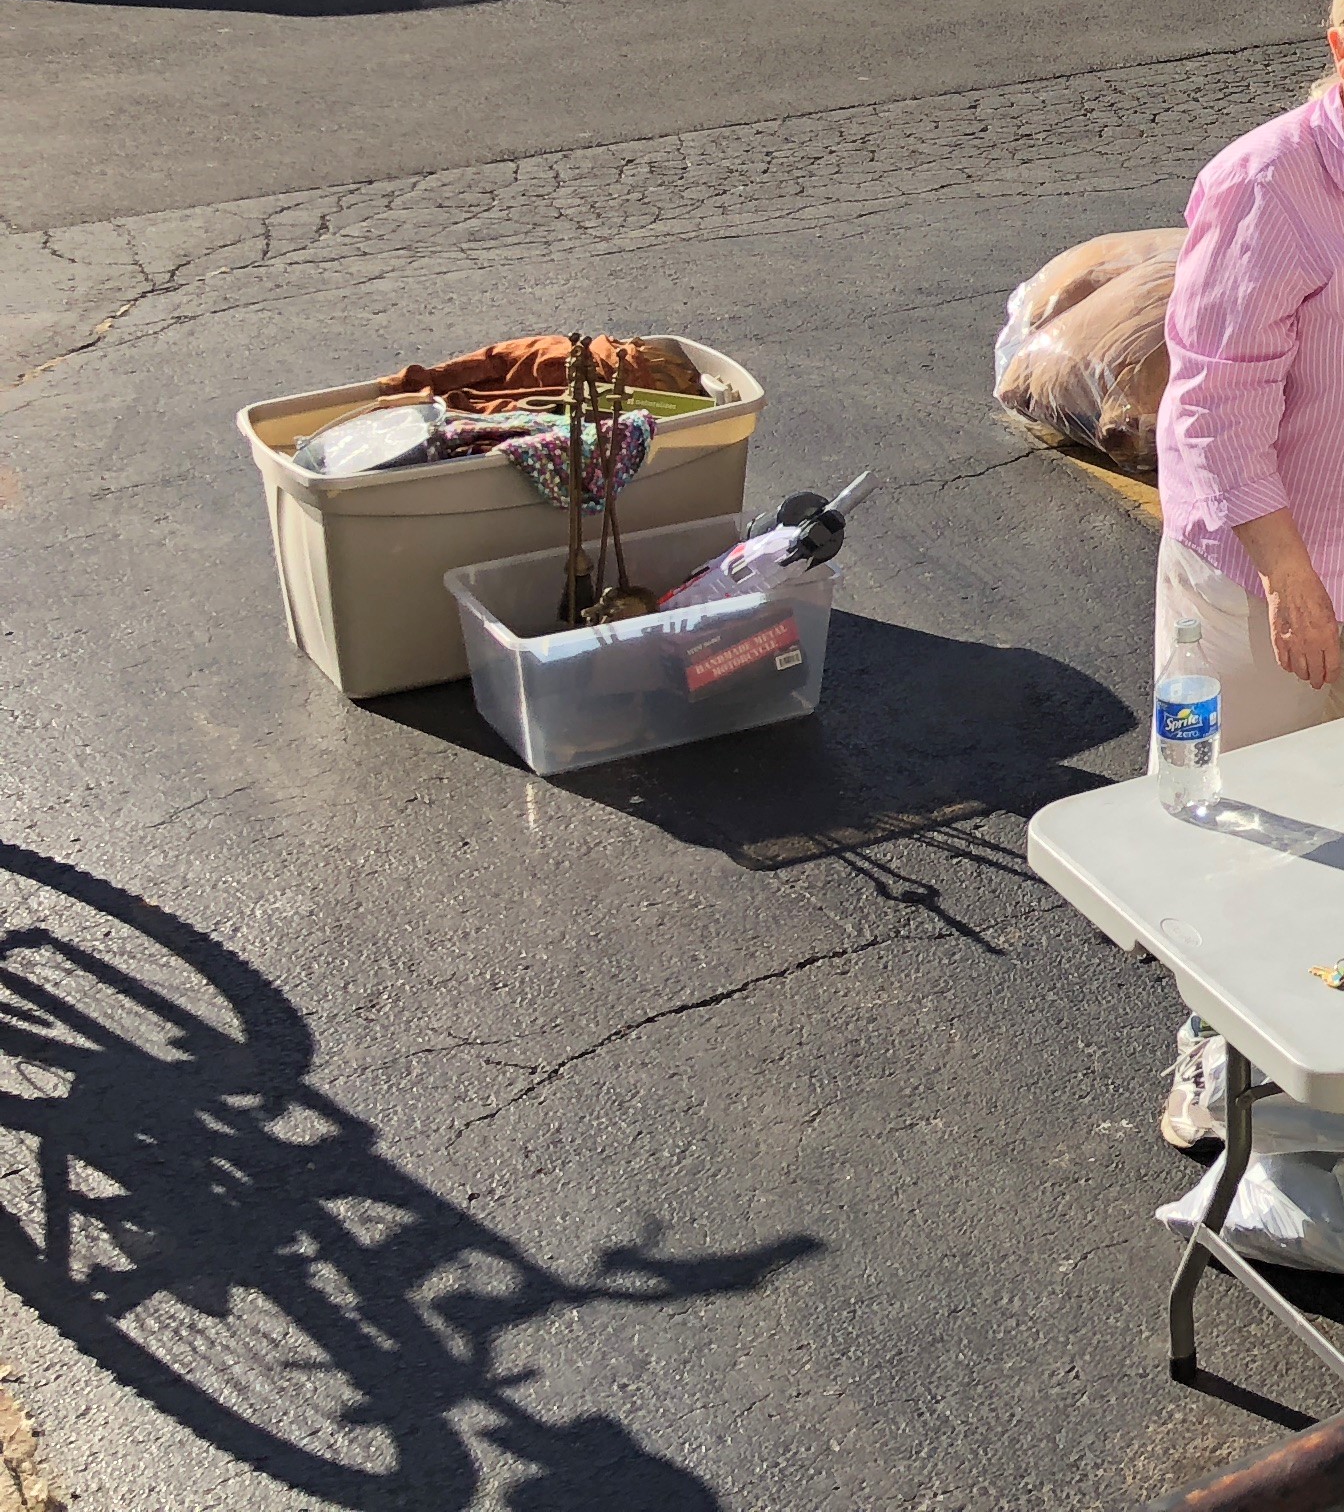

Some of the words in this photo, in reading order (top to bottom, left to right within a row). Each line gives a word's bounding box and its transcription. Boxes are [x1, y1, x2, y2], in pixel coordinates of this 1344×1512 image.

[753, 624, 788, 644] METAL
[1165, 713, 1200, 731] Sprite
[1176, 729, 1200, 738] zero
